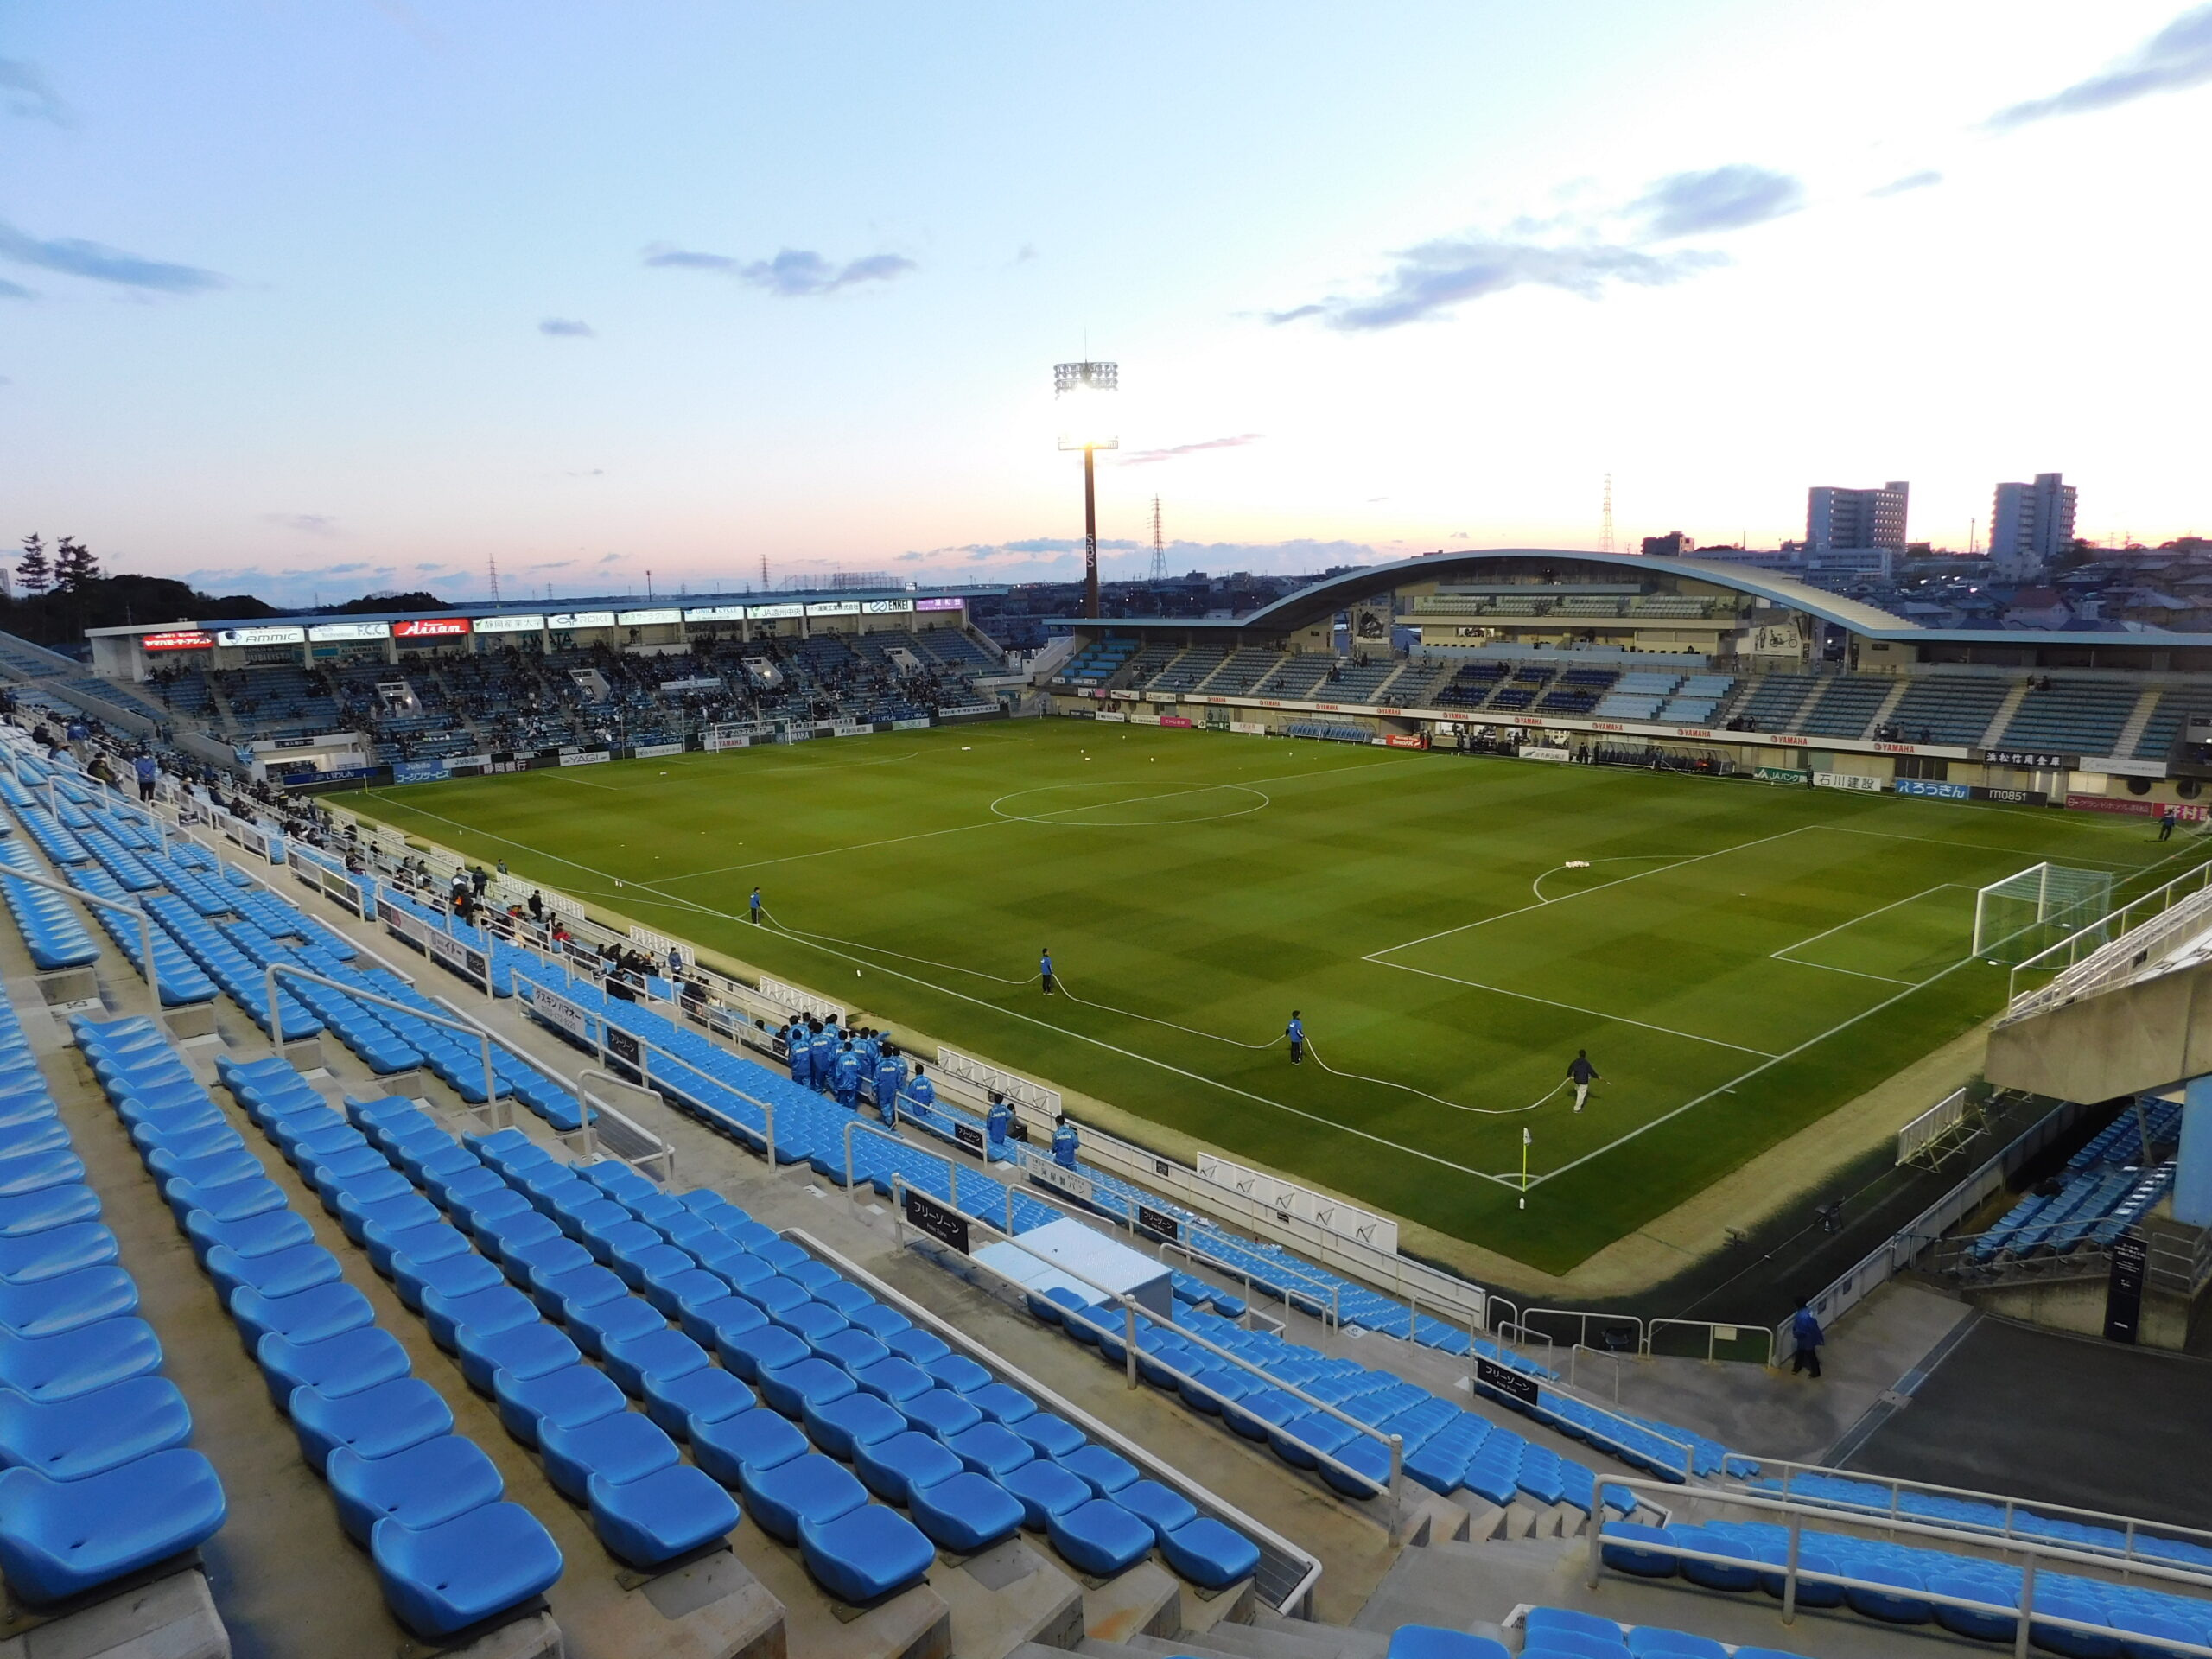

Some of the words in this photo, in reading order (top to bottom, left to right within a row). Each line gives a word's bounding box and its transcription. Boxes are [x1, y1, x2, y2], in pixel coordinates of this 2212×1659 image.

[1086, 533, 1095, 568] SBS
[888, 600, 909, 611] ENKEI
[762, 607, 802, 617] JA遠州中央
[484, 617, 543, 629] 静岡産業大学
[579, 614, 607, 624] ROKI
[358, 625, 385, 636] F.C.C.
[398, 622, 466, 636] Aisan
[245, 632, 298, 643] AMMIC
[1685, 729, 1711, 738] YAMAHA
[719, 739, 743, 747] YAMAHA
[1778, 736, 1808, 745] YAMAHA
[1883, 743, 1915, 753] YAMAHA
[569, 753, 599, 763] YAGI
[1986, 751, 2061, 766] 浜松信用金庫
[483, 761, 527, 775] 静岡銀行
[327, 770, 354, 780] いわしん
[1770, 773, 1800, 783] JAバンク
[1819, 774, 1875, 790] 石川建設
[1912, 782, 1966, 798] ろうきん
[1989, 789, 2027, 802] m0851
[445, 942, 462, 956] イトー
[536, 989, 557, 1008] ダスキン
